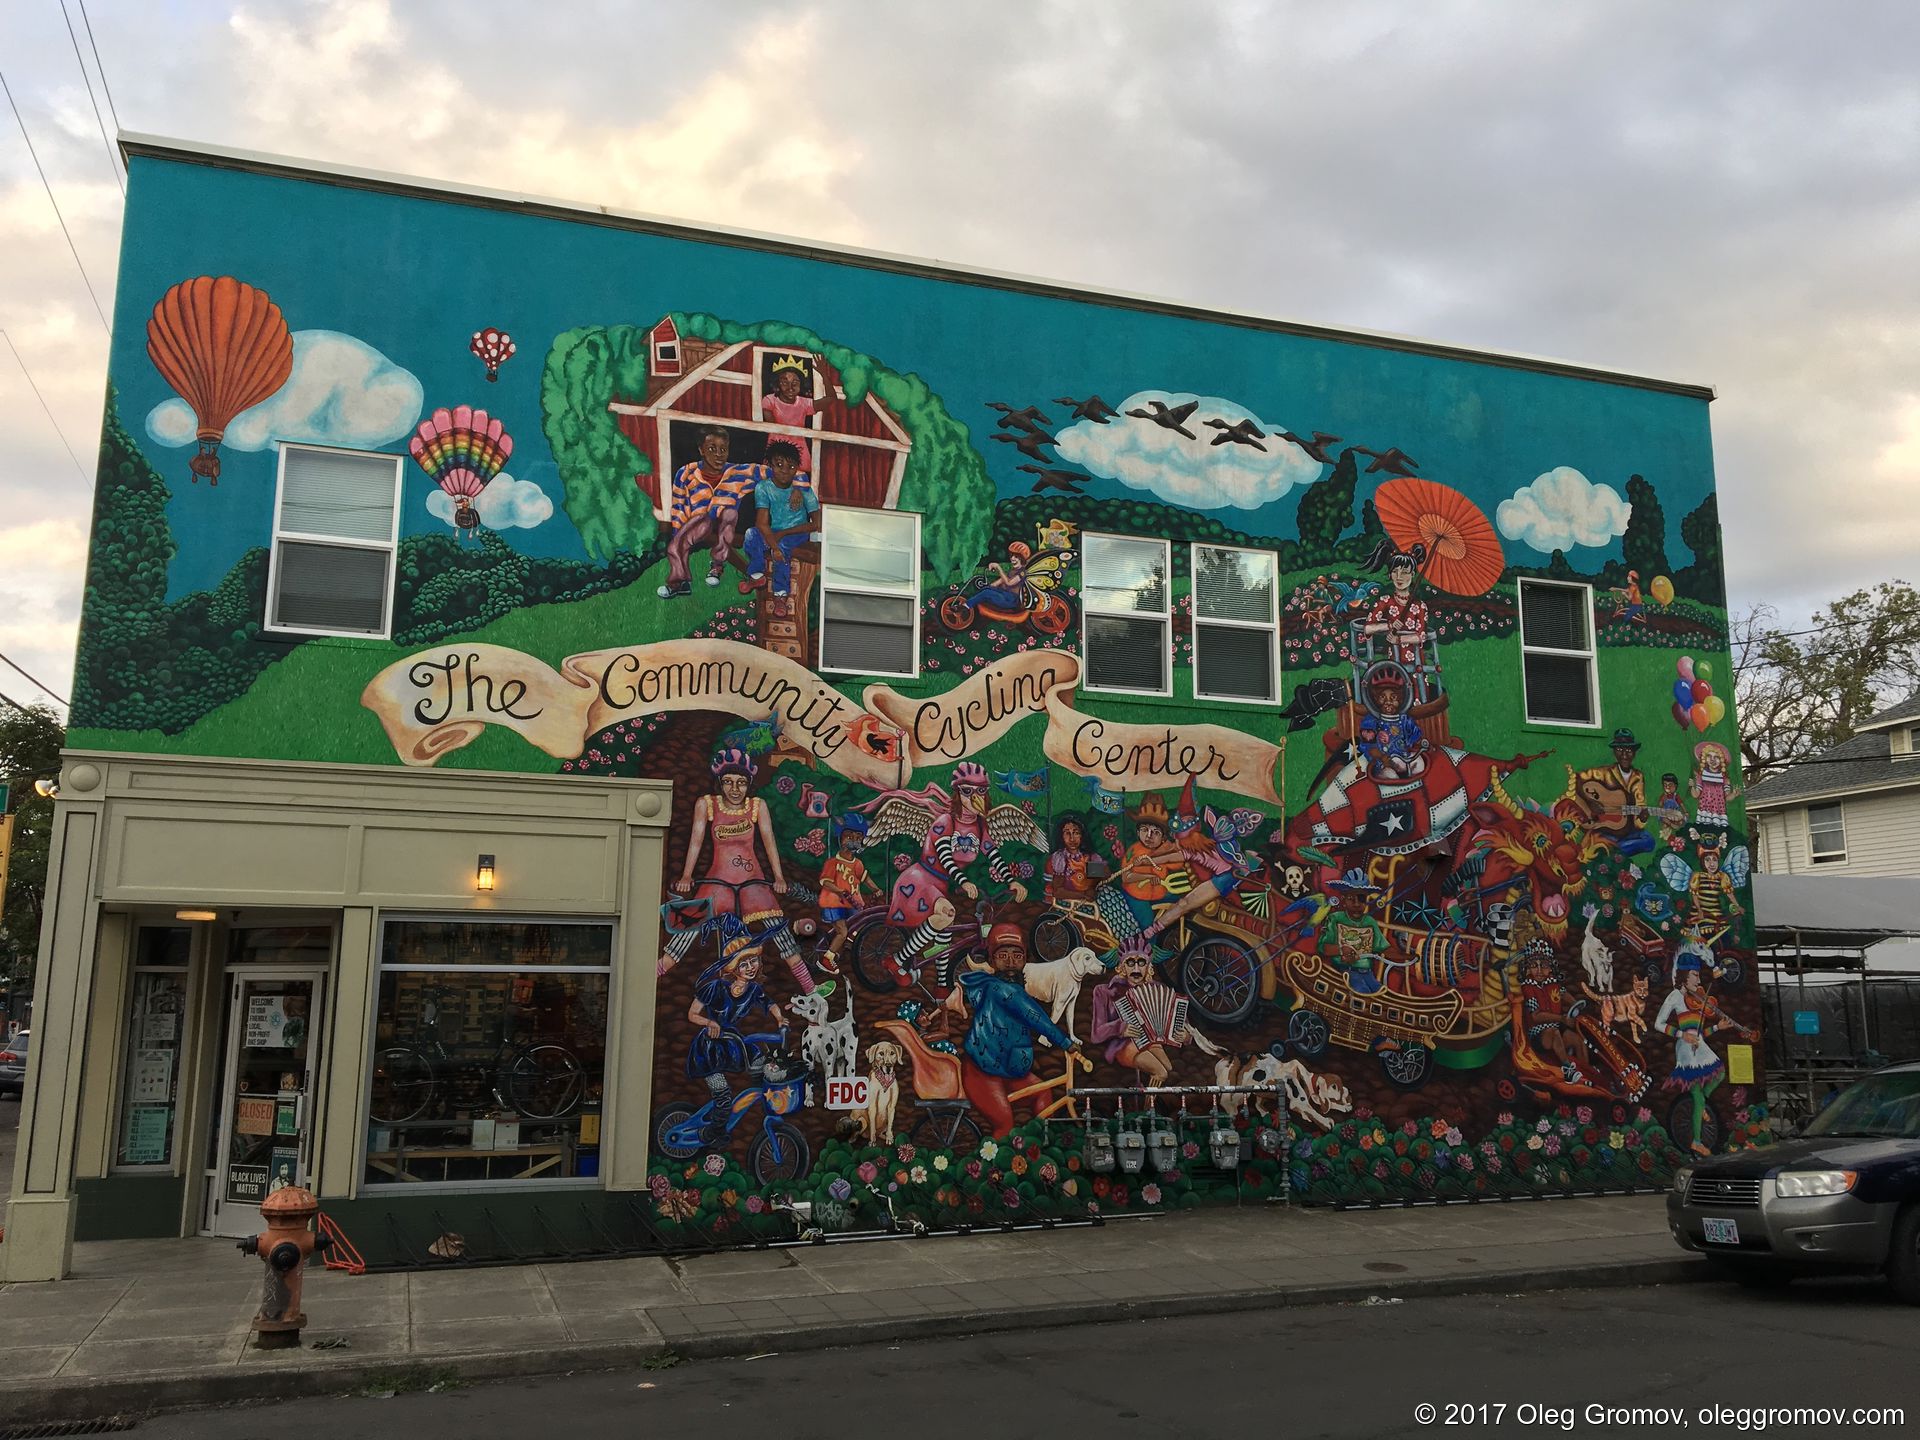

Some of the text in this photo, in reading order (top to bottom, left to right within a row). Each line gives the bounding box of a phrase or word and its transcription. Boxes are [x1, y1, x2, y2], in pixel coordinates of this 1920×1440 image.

[408, 653, 1241, 782] The Community Cycling Center
[836, 863, 859, 895] MEOW
[251, 998, 274, 1007] WELCOME
[828, 1081, 867, 1105] FDC
[239, 1102, 273, 1120] CLOSED
[231, 1171, 266, 1184] BLACK LIVES
[236, 1183, 259, 1195] MATTER
